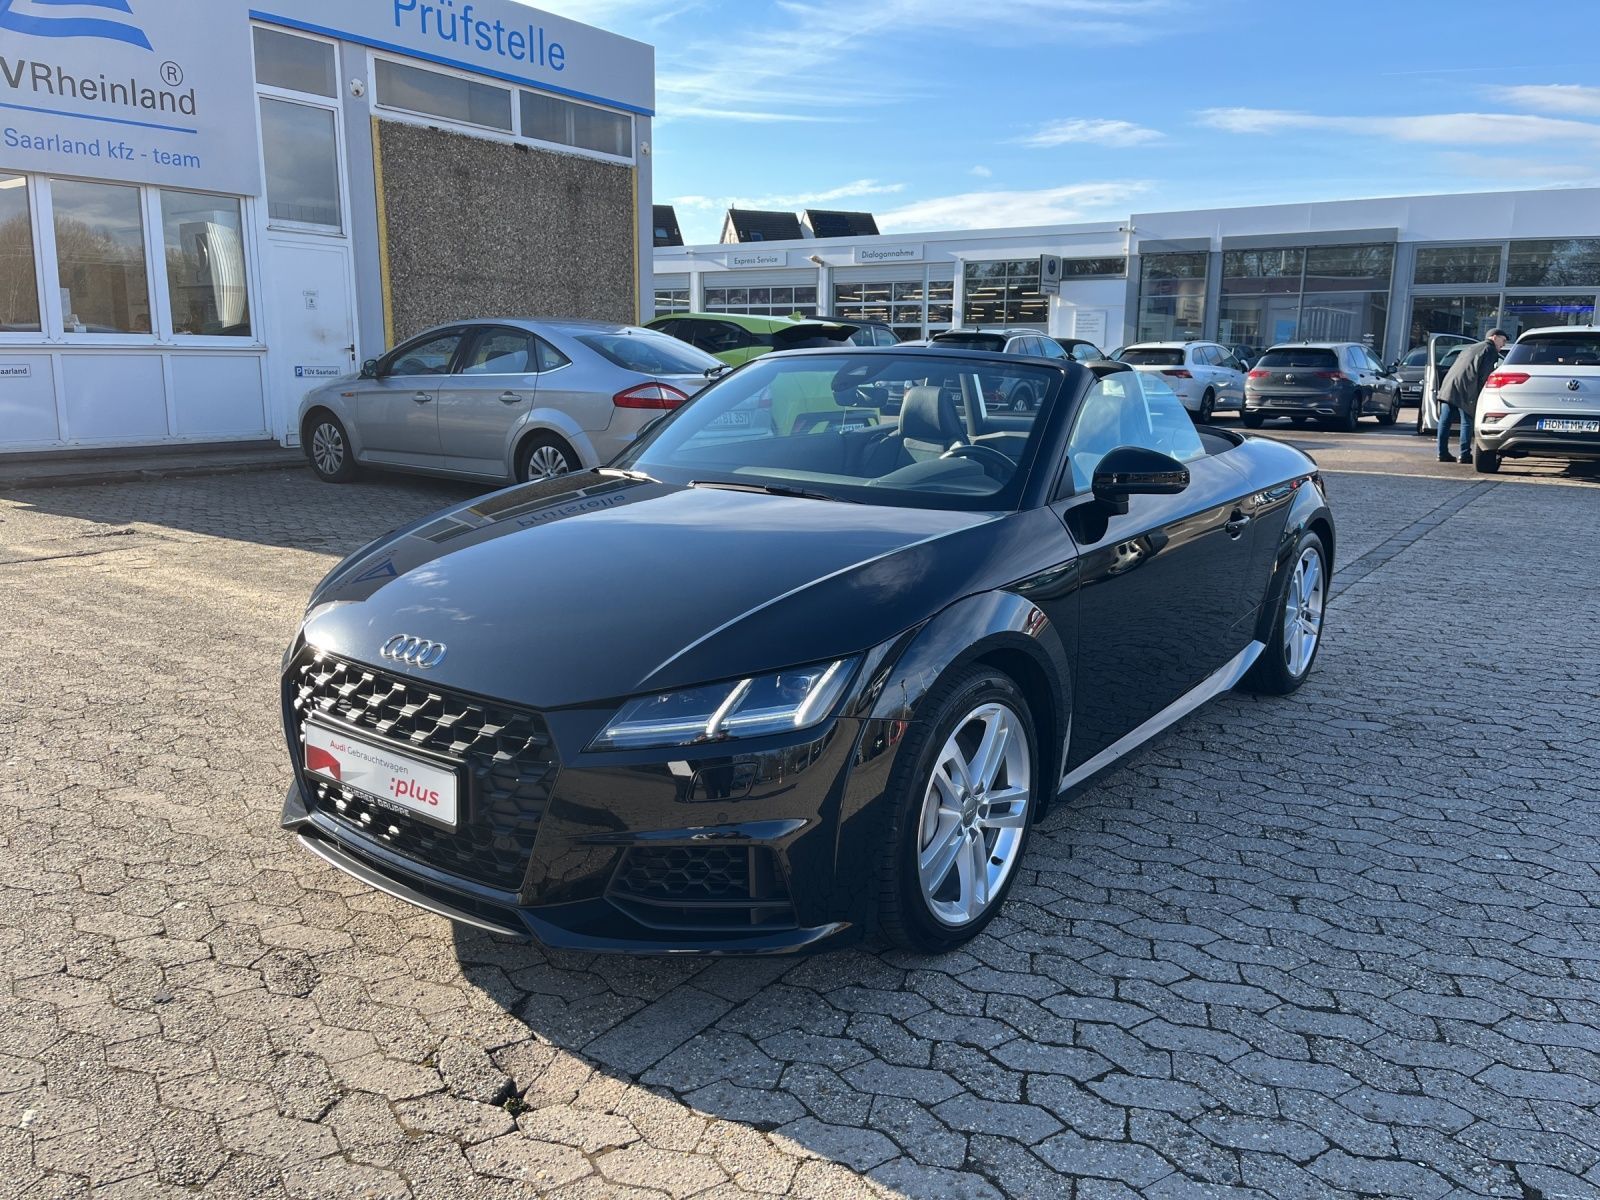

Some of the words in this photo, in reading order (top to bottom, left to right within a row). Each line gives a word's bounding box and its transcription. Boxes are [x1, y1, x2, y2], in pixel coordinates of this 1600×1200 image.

[394, 0, 565, 71] Prüfstelle
[4, 128, 100, 157] Saarland
[108, 141, 135, 161] kfz
[153, 148, 200, 169] team
[734, 257, 756, 266] Express
[757, 256, 778, 264] Service
[861, 249, 915, 260] Dialogannahme
[330, 739, 347, 753] Audi
[348, 746, 409, 774] Gebrauchtwagen
